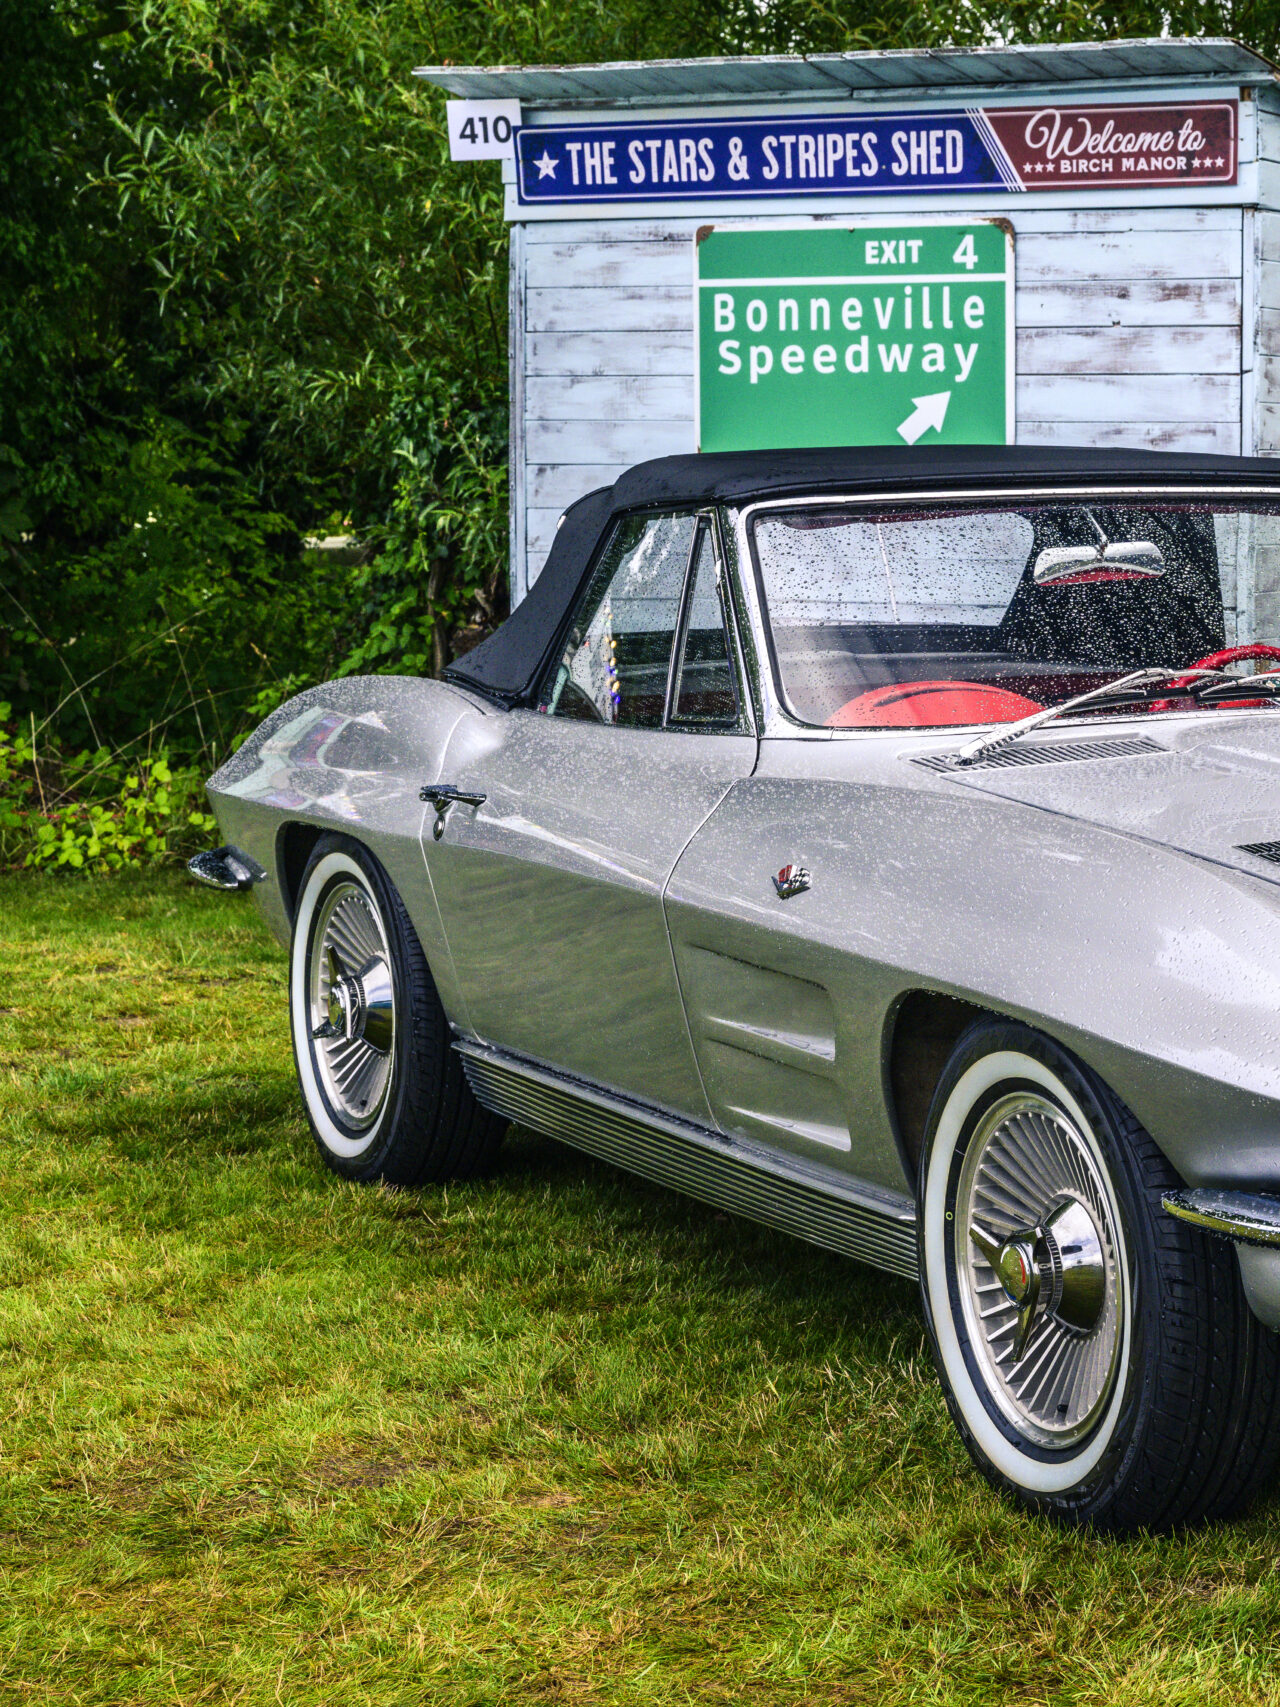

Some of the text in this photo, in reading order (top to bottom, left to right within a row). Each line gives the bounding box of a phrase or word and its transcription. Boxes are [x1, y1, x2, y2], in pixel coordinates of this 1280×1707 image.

[459, 115, 512, 145] 410
[1024, 108, 1206, 159] Welcome to
[566, 129, 964, 186] THE STARS & STRIPES SHED
[1060, 155, 1187, 174] BIRCH MANOR
[865, 234, 978, 270] EXIT 4
[713, 285, 985, 332] Bonneville
[718, 335, 979, 384] Speedway
